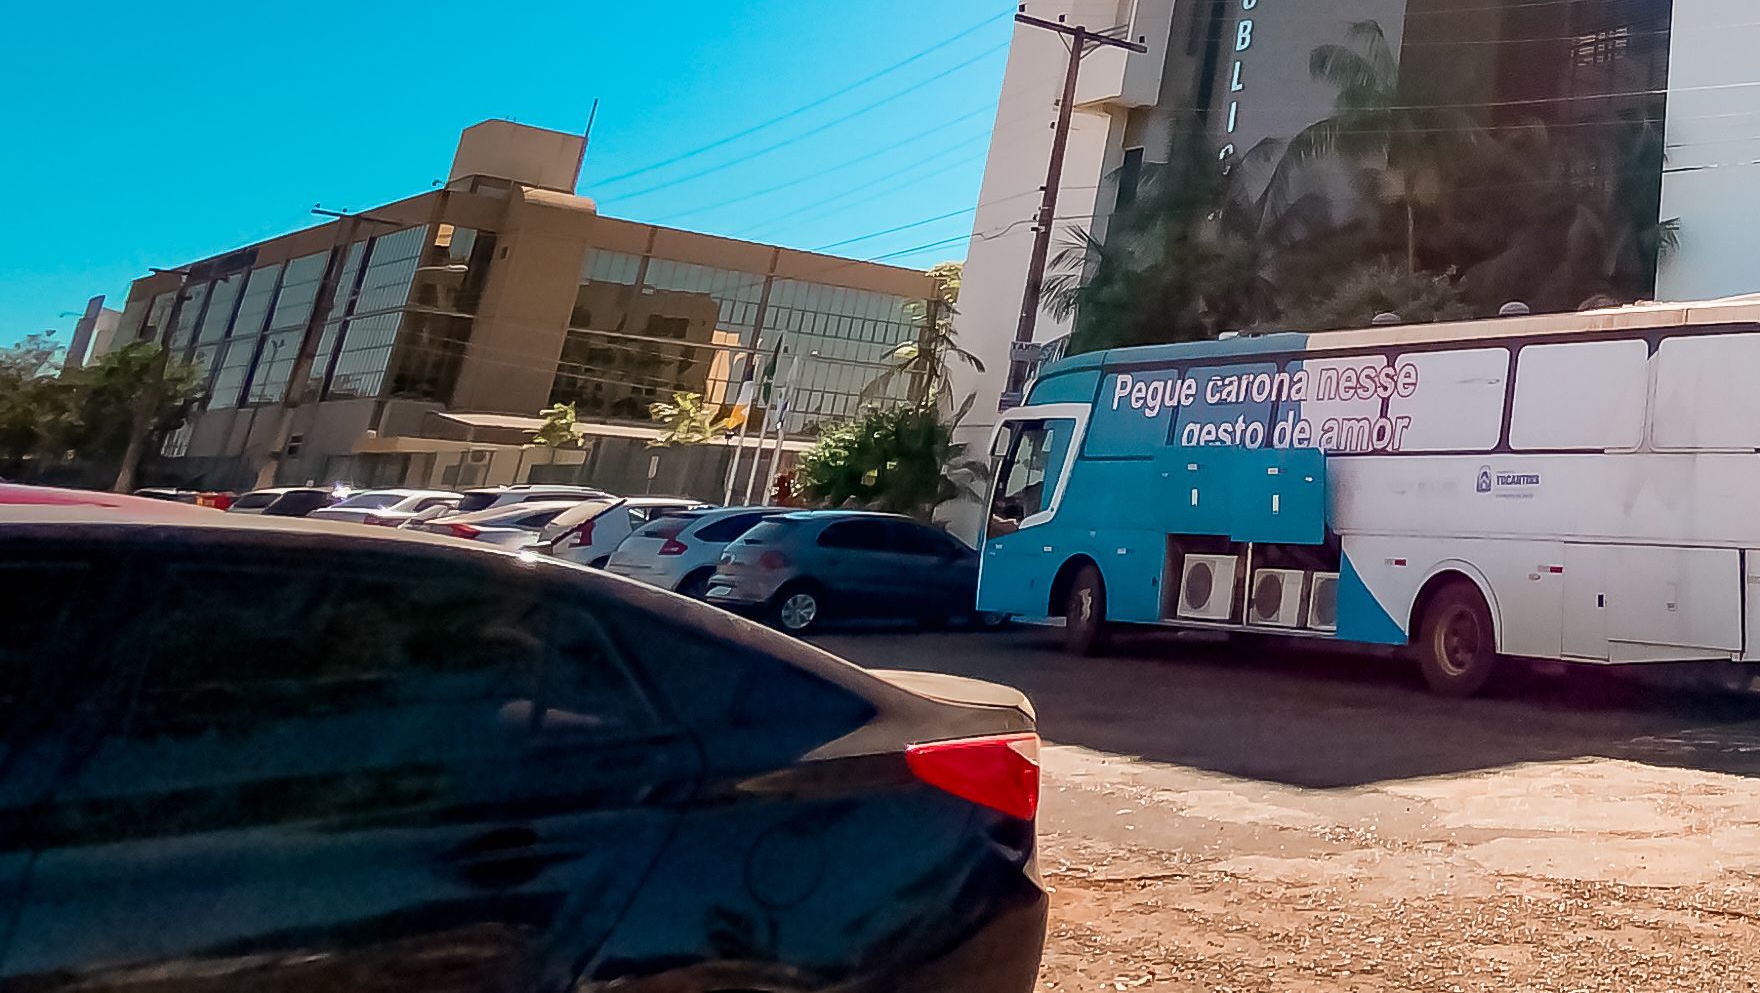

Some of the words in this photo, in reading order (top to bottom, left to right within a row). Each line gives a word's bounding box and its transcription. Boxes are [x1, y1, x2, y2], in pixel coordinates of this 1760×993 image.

[1112, 373, 1198, 417] Pegue
[1204, 369, 1309, 404] carona
[1316, 362, 1419, 401] nesse
[1273, 410, 1313, 448] de
[1320, 416, 1413, 451] amor
